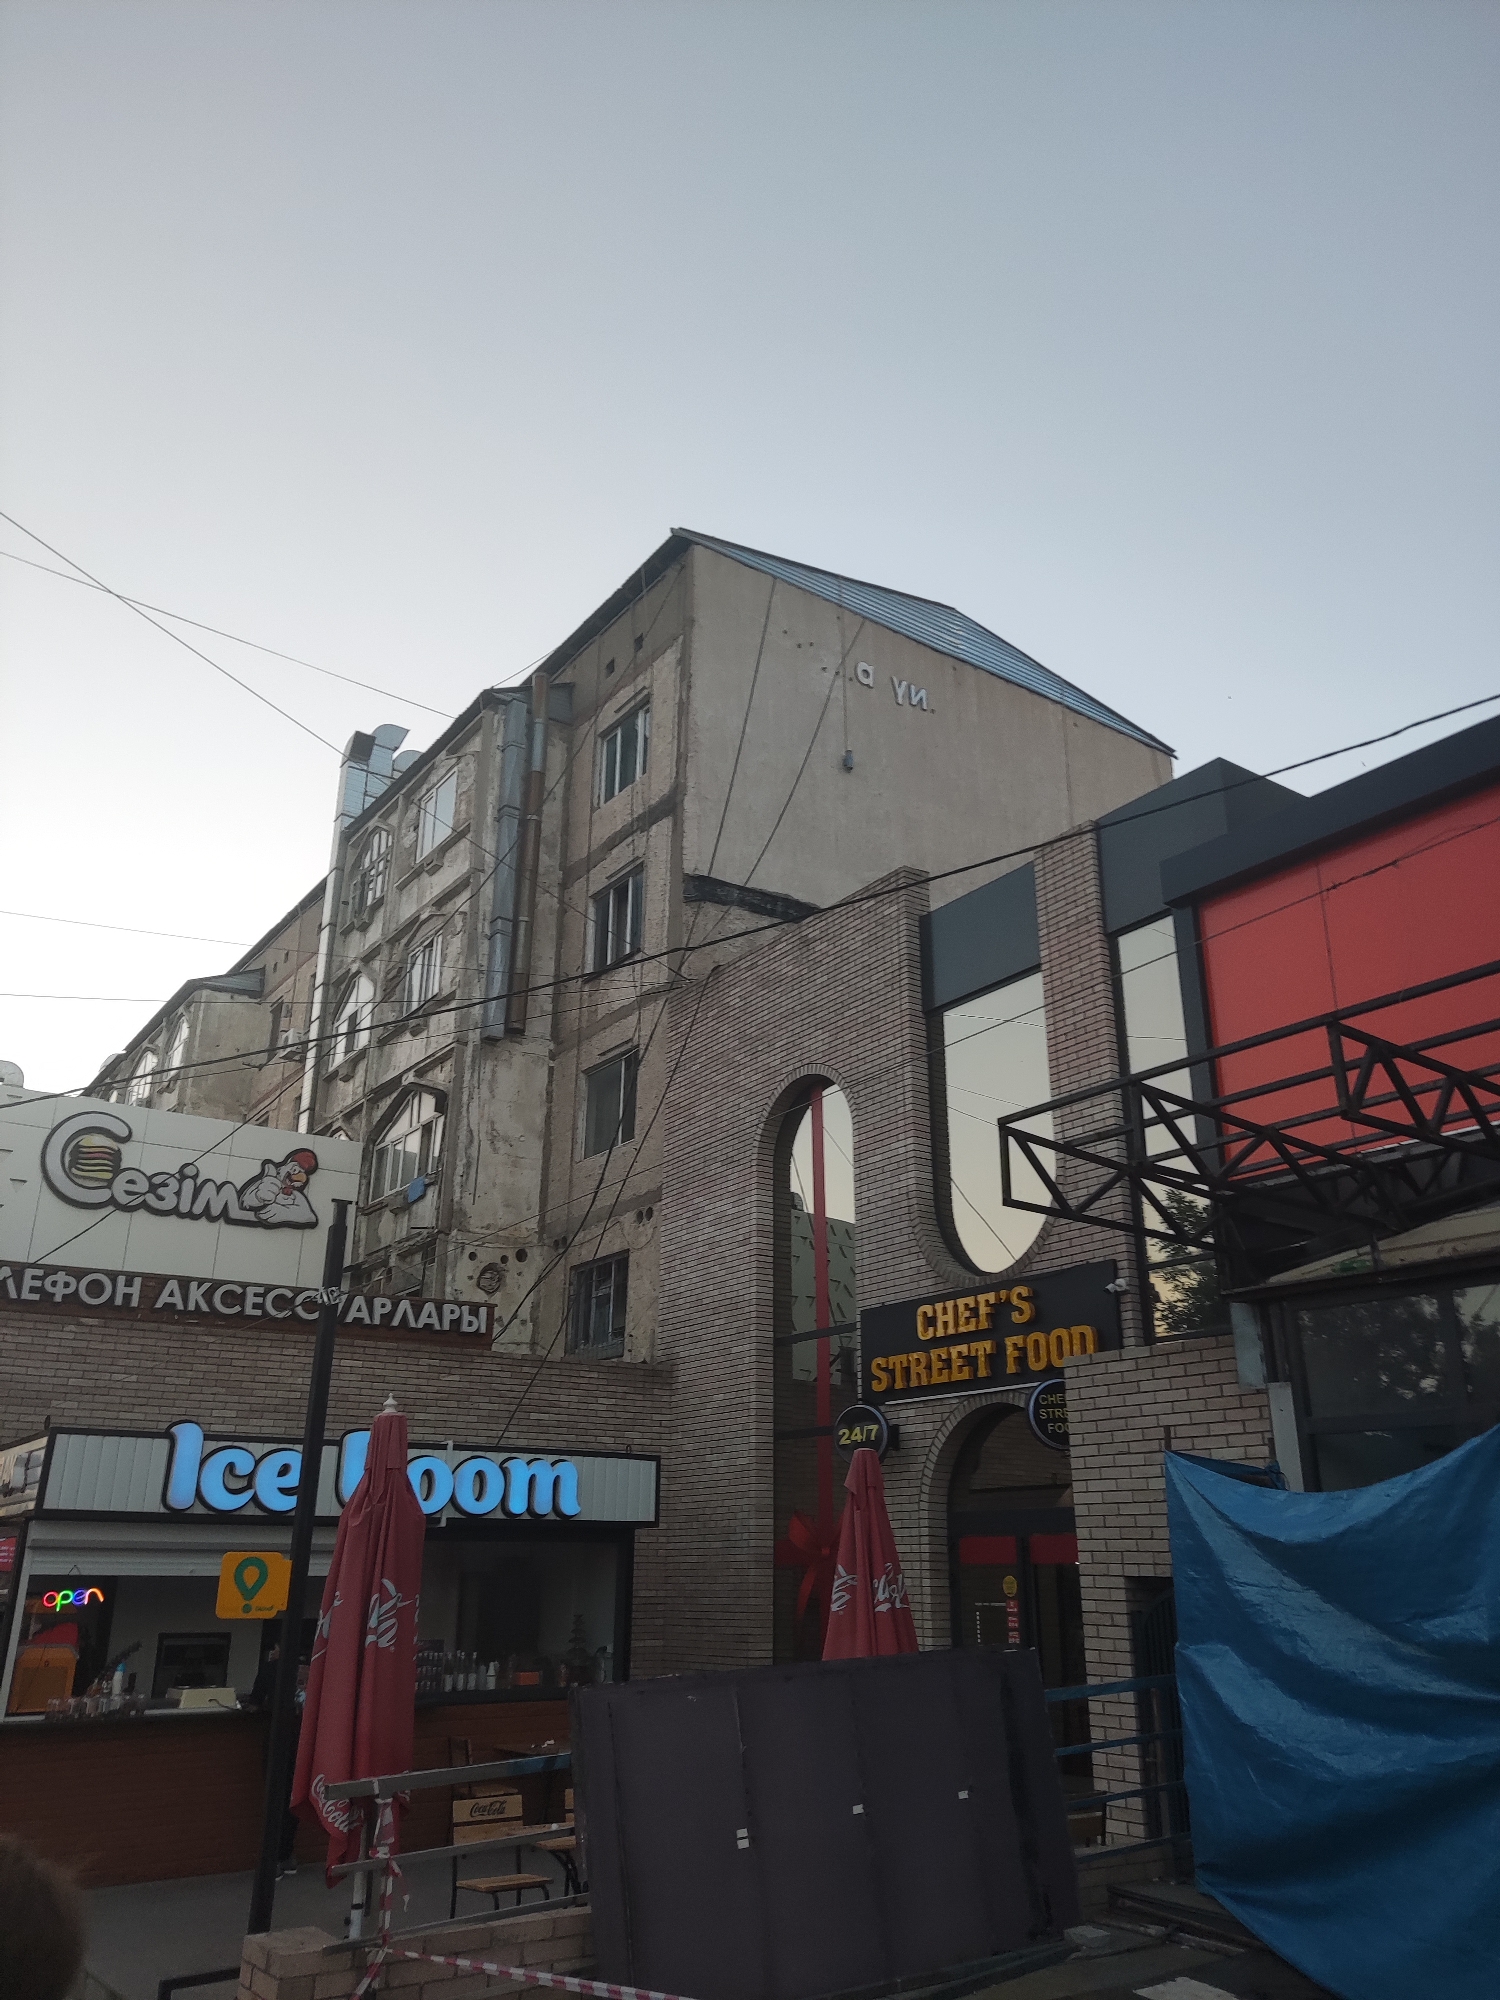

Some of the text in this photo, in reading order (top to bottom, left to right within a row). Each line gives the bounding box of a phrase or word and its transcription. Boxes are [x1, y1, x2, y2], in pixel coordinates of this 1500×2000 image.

[917, 1285, 1035, 1340] CHEF'S
[871, 1324, 1098, 1392] STREET FOOD
[838, 1423, 880, 1446] 24/7
[164, 1420, 303, 1512] Ice
[42, 1587, 105, 1613] open
